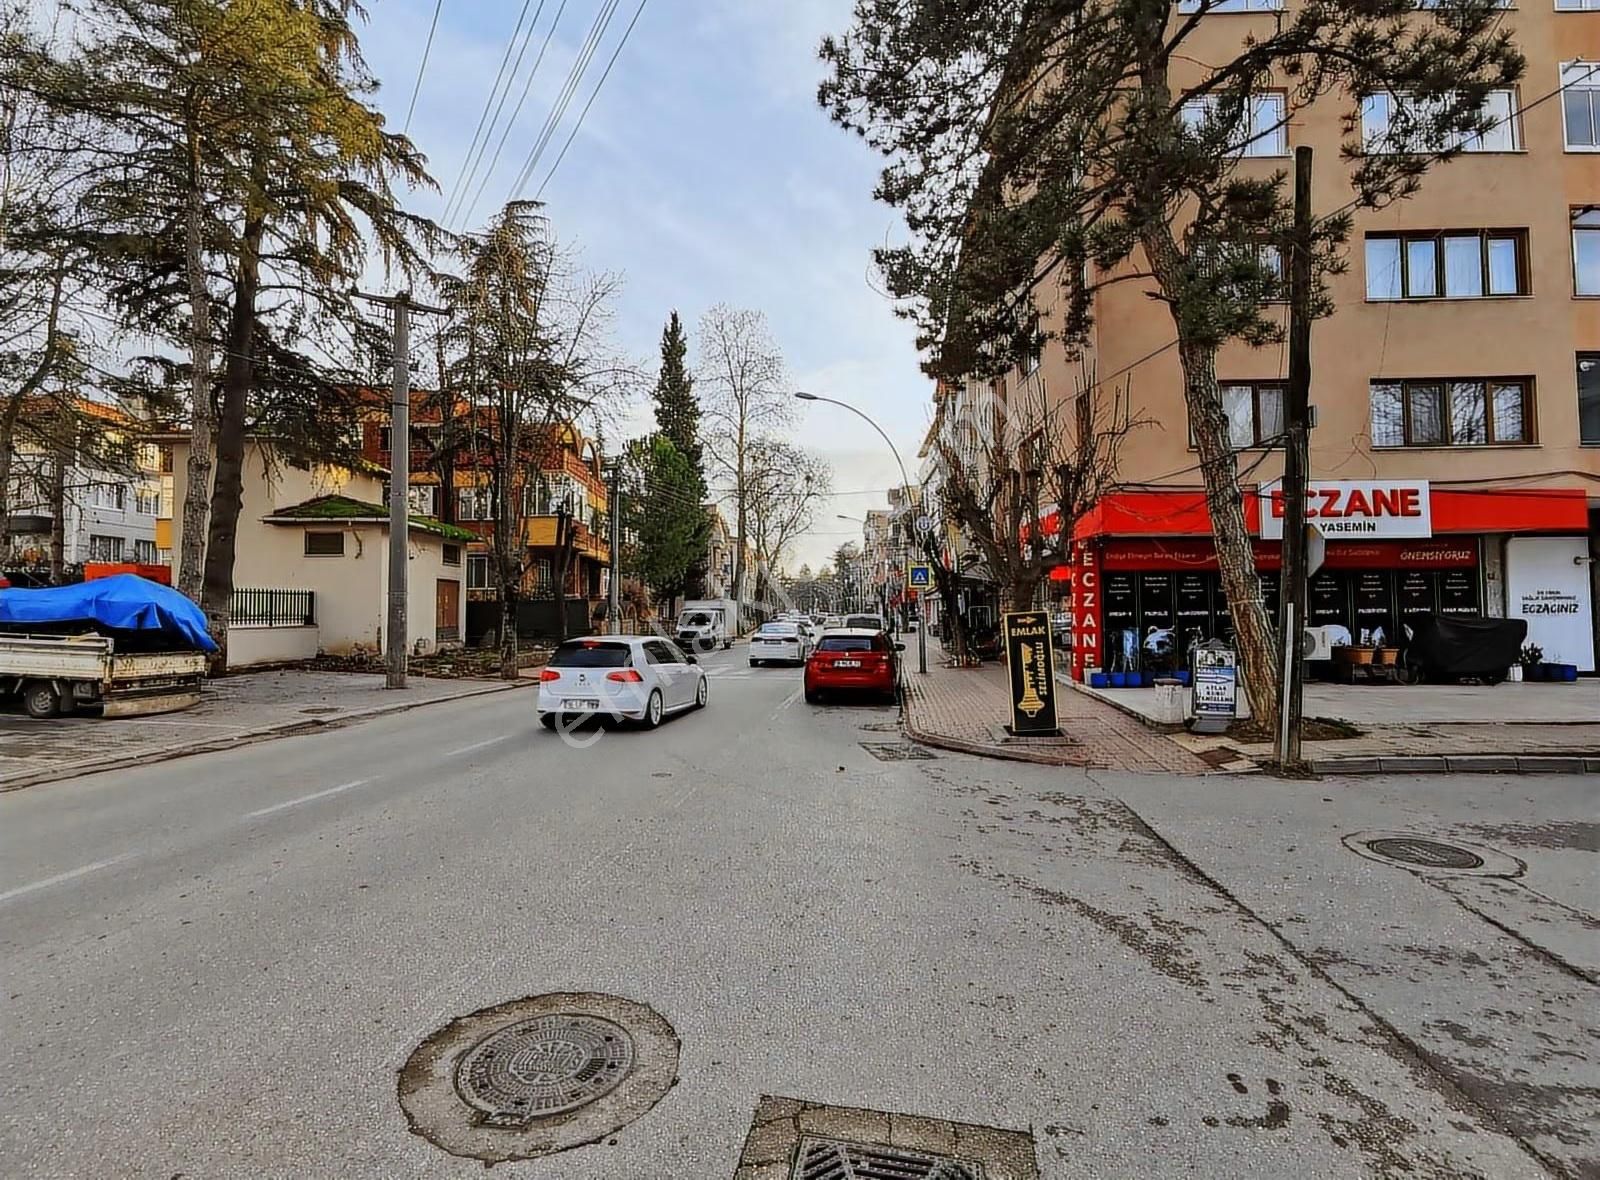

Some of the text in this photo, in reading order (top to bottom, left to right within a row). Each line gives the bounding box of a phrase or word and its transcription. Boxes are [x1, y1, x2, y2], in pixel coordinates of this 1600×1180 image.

[1320, 521, 1376, 532] YASEMİN
[1083, 553, 1096, 667] ECZANE
[1522, 603, 1579, 614] ECZACINIZ
[1011, 626, 1046, 637] EMLAK
